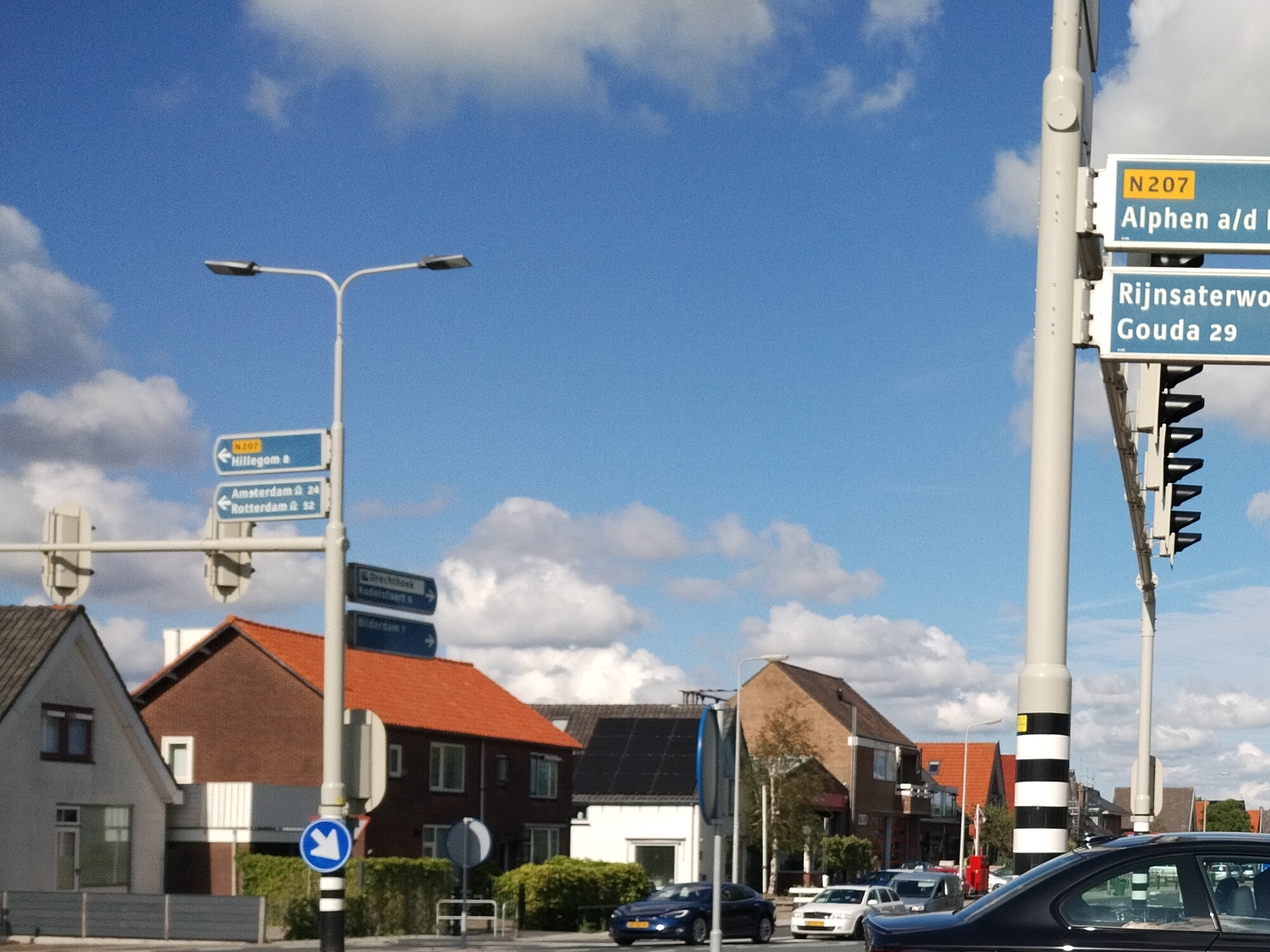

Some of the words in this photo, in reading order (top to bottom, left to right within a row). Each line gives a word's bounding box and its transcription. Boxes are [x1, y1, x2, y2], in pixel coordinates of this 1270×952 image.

[1129, 175, 1189, 194] N207
[1121, 205, 1209, 234] Alphen
[1217, 208, 1257, 231] a/d
[1117, 317, 1200, 341] Gouda
[1209, 323, 1238, 342] 29
[234, 441, 259, 451] N207
[231, 454, 281, 468] Hillegom
[231, 485, 293, 499] Amsterdam
[307, 485, 320, 495] 24
[230, 501, 288, 515] Rotterdam
